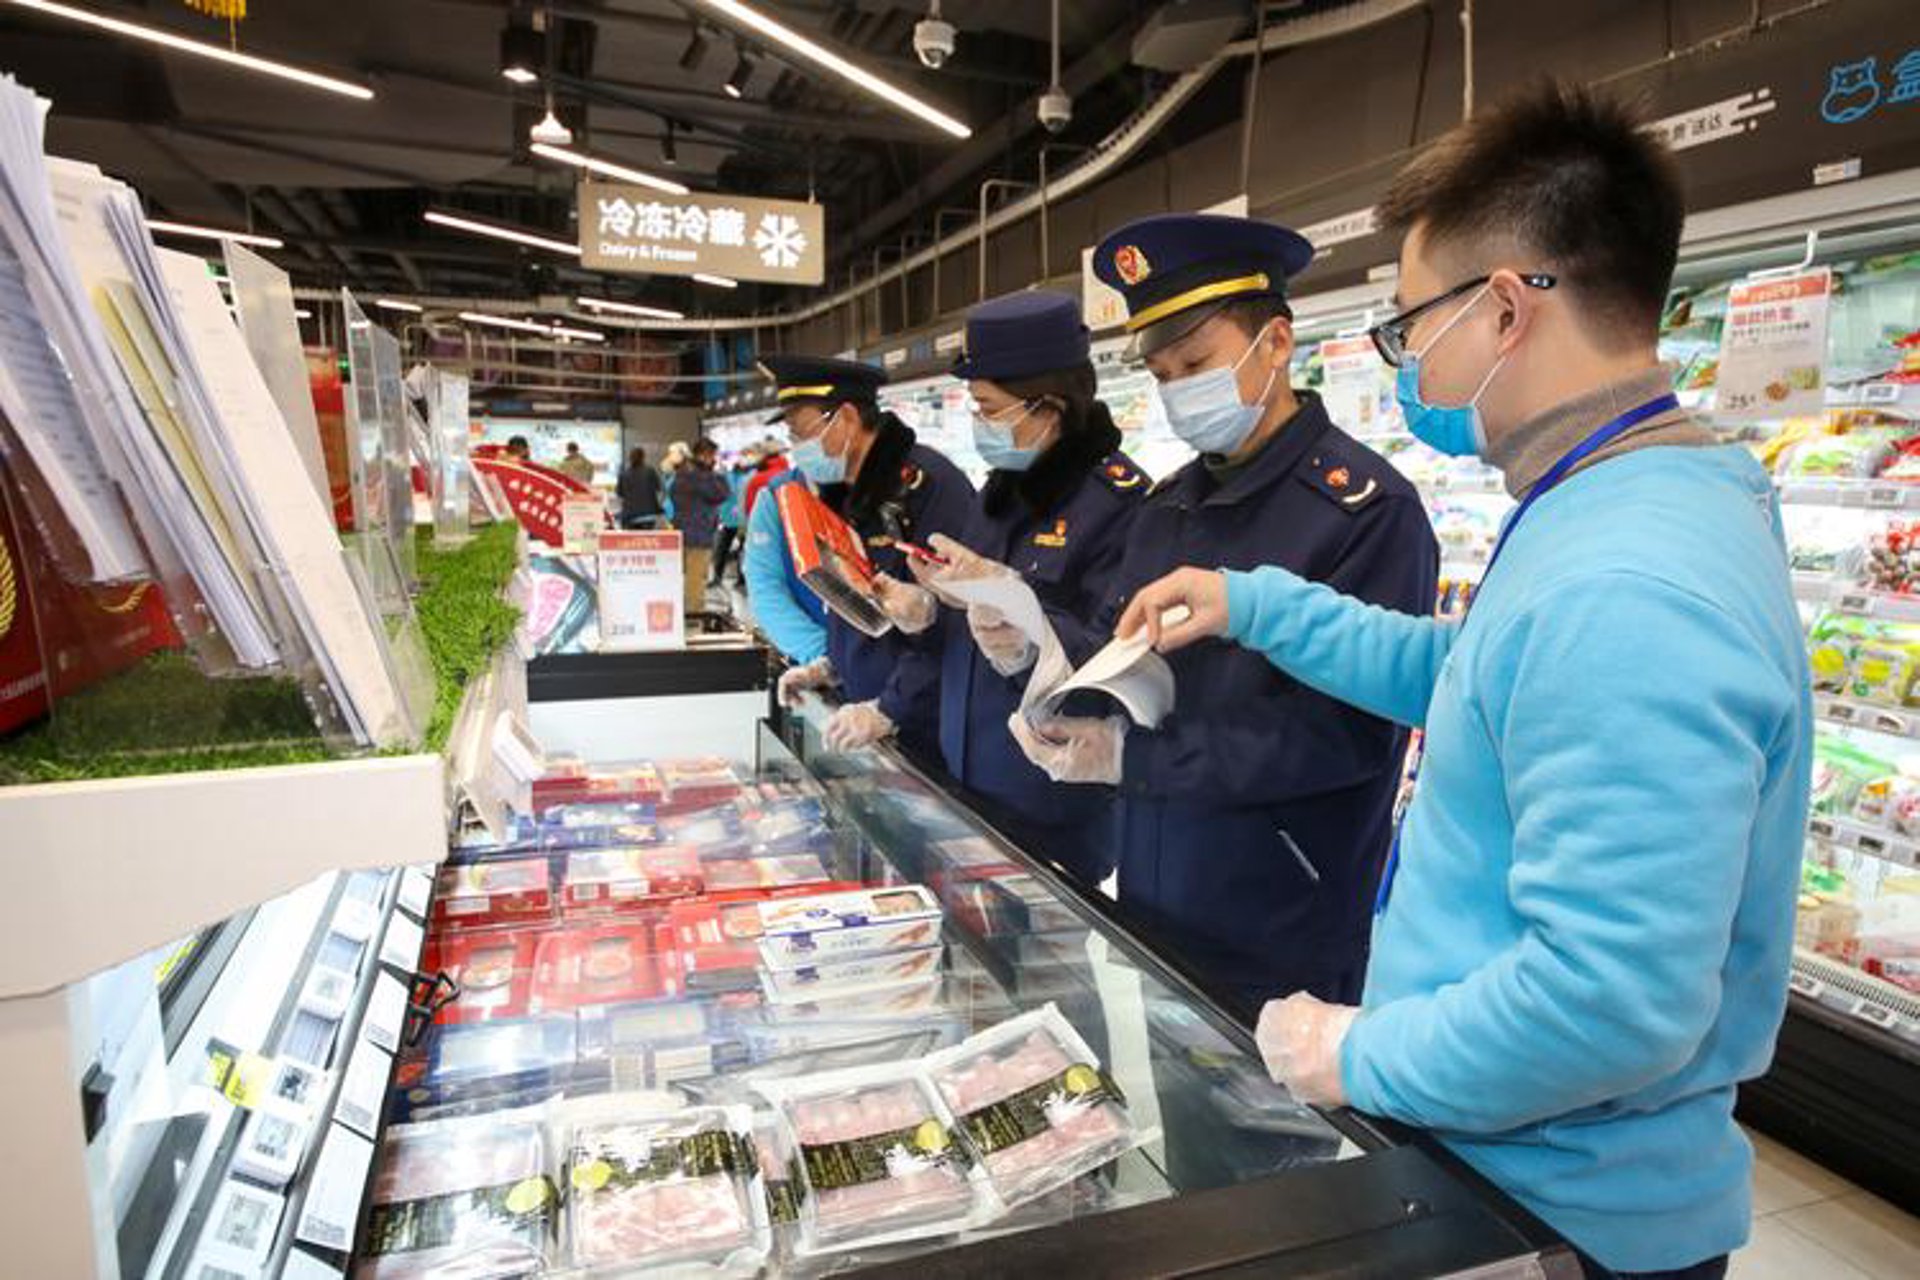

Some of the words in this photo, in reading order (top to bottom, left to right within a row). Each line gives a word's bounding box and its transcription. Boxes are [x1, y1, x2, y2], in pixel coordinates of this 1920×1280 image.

[598, 197, 746, 246] 冷冻冷藏
[599, 241, 638, 261] Dairy
[652, 244, 697, 262] Frozen
